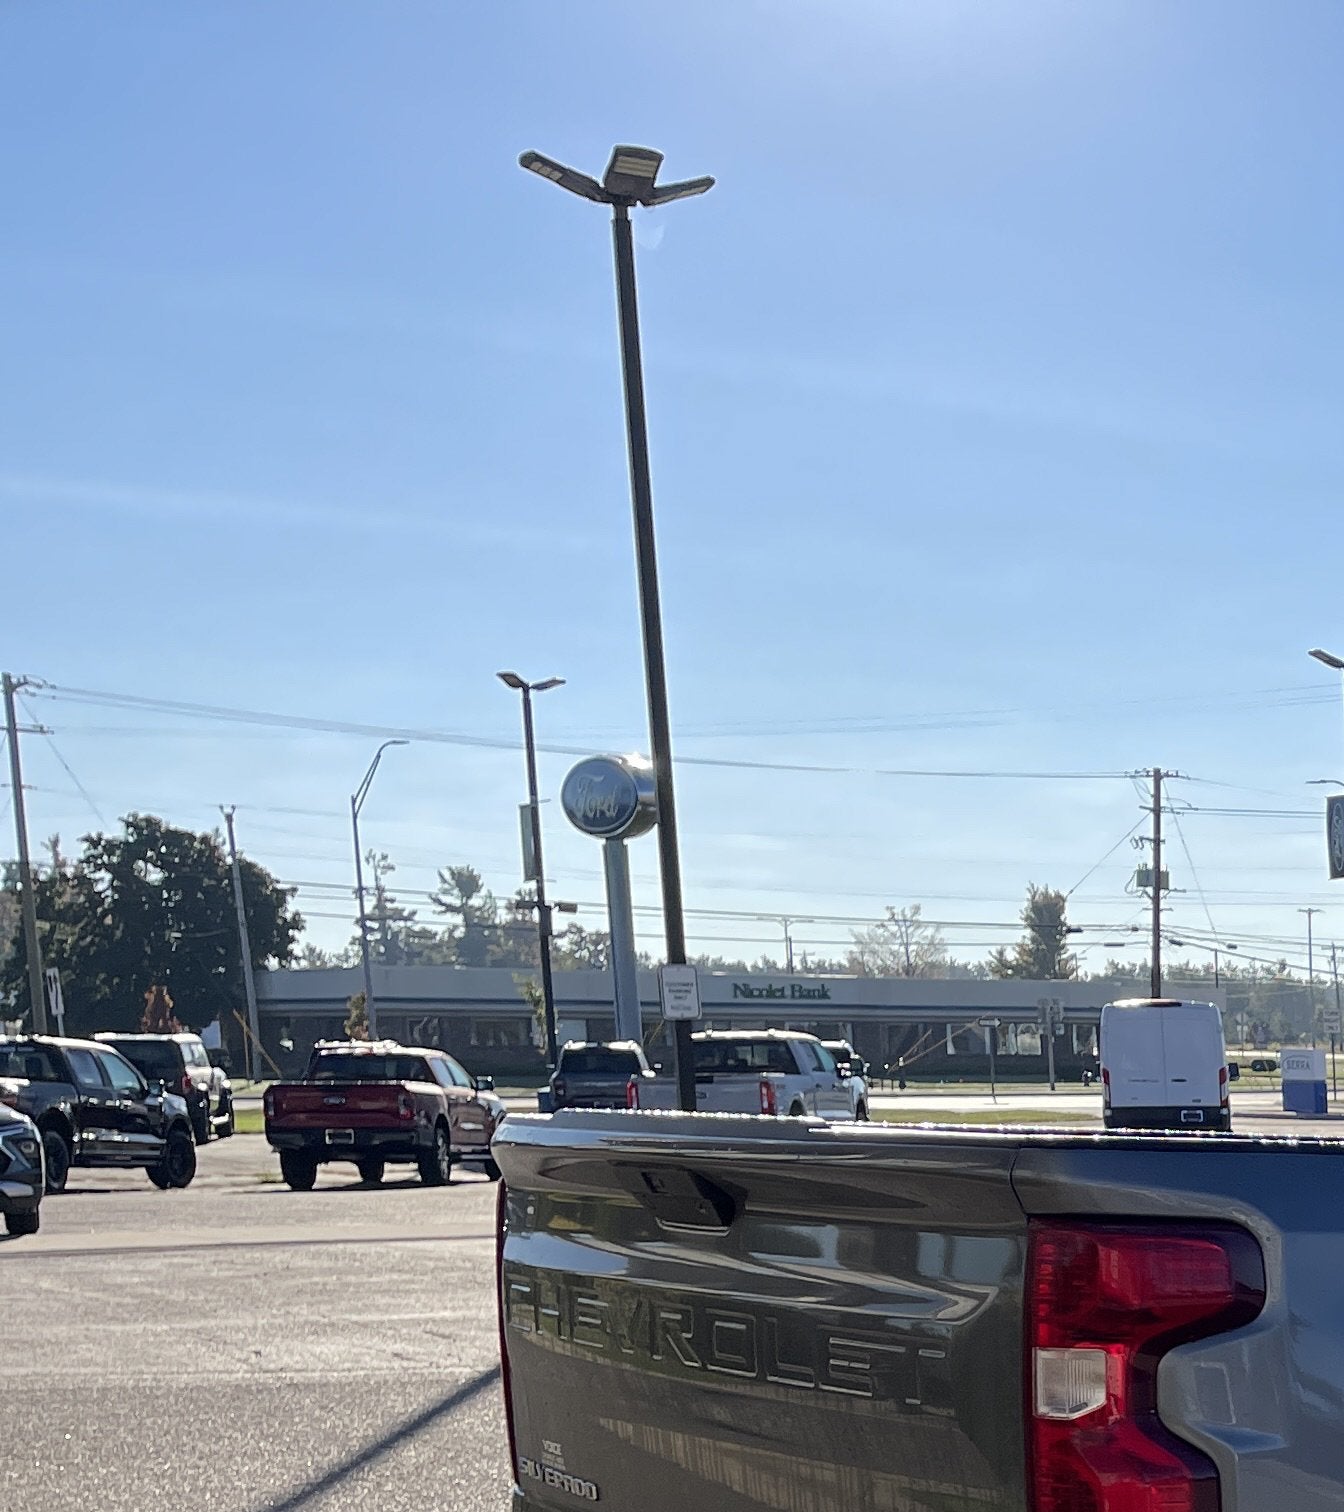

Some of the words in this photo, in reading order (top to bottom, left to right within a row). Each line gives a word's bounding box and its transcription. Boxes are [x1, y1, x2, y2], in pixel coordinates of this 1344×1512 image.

[573, 772, 619, 819] Ford
[732, 982, 786, 999] Nicolet
[790, 983, 831, 999] Bank
[506, 1274, 949, 1405] CHEVROLET
[518, 1456, 599, 1501] SILVERADO
